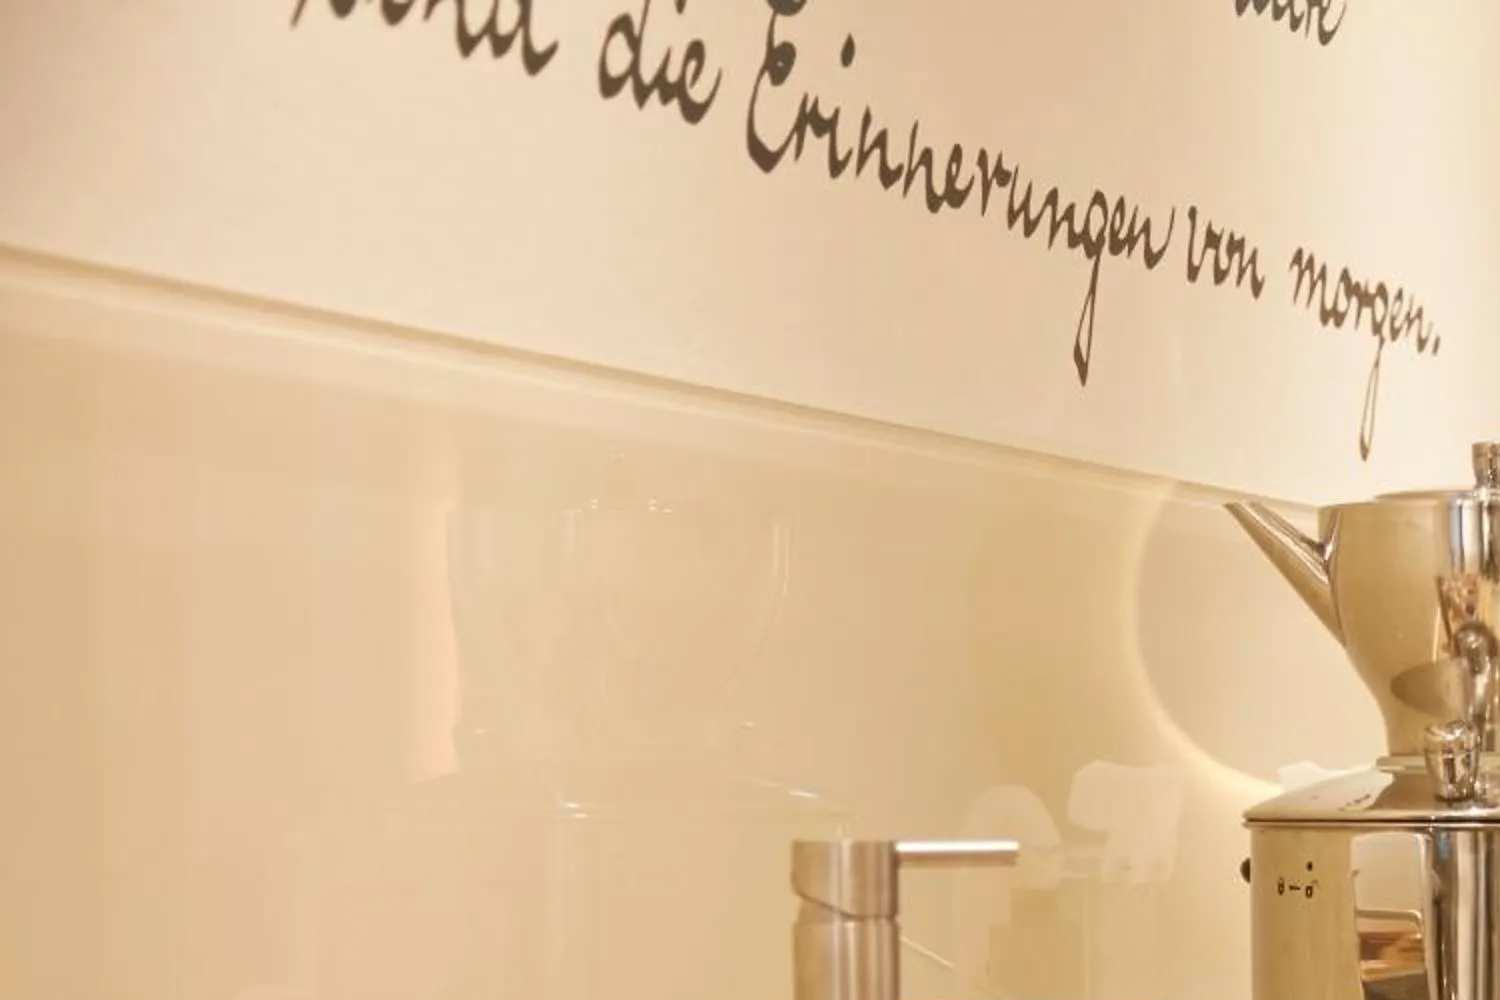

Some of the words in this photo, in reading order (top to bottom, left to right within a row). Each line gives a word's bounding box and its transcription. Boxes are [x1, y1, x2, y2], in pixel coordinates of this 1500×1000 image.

[597, 0, 723, 126] die
[746, 0, 1176, 388] Erinnerungen
[1186, 205, 1266, 300] von
[1288, 246, 1441, 462] morgen.
